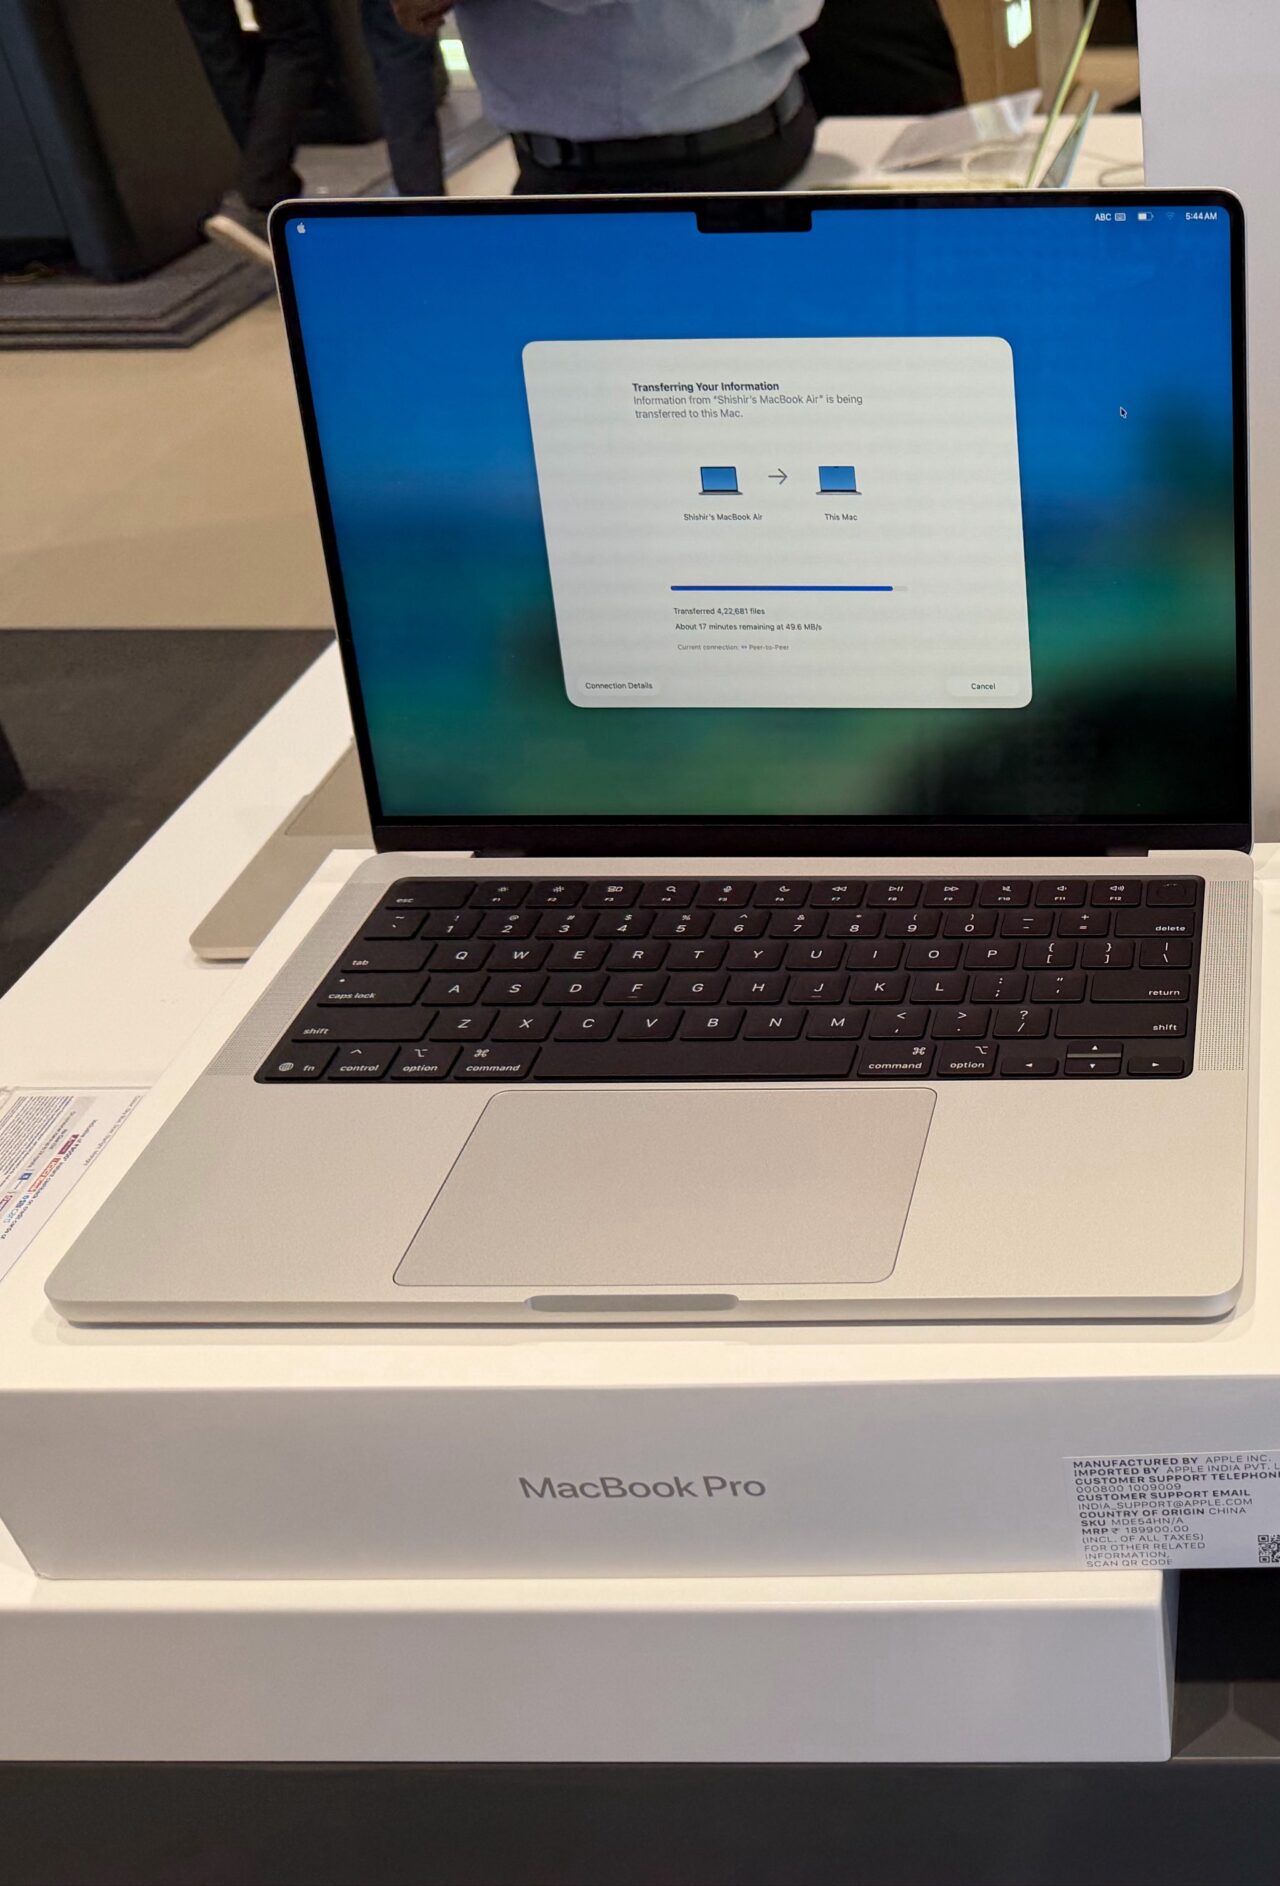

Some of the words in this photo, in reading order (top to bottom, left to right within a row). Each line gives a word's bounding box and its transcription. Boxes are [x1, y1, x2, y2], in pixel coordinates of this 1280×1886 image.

[1095, 213, 1111, 221] ABC
[632, 383, 694, 393] Transferring
[696, 383, 718, 392] Your
[721, 382, 780, 391] Information
[634, 396, 687, 405] Information
[689, 396, 711, 404] from
[760, 395, 804, 404] MacBook
[826, 395, 834, 404] is
[837, 394, 863, 405] being
[635, 410, 687, 418] transferred
[689, 410, 699, 418] to
[701, 409, 718, 418] this
[721, 409, 744, 418] Mac.
[683, 513, 715, 521] Shishir's
[717, 513, 750, 521] MacBook
[753, 513, 763, 521] Air
[825, 513, 840, 521] This
[842, 513, 857, 521] Mac
[717, 608, 748, 616] 4,22,681
[739, 623, 775, 632] remaining
[585, 682, 626, 690] Connection
[971, 682, 996, 690] Cancel
[1155, 924, 1186, 932] delete
[352, 958, 369, 966] tab
[328, 992, 352, 1001] caps
[353, 991, 376, 1000] lock
[1148, 989, 1180, 997] return
[303, 1026, 330, 1035] shift
[1152, 1023, 1178, 1031] shift
[303, 1064, 315, 1072] fn
[340, 1064, 379, 1072] control
[402, 1064, 438, 1074] option
[466, 1063, 520, 1072] command
[868, 1062, 922, 1070] command
[950, 1061, 985, 1070] option
[1073, 1458, 1179, 1468] MANUFACTURED
[1182, 1457, 1198, 1465] BY
[1205, 1456, 1243, 1464] APPLE
[1247, 1454, 1271, 1463] INC.
[1074, 1468, 1139, 1477] IMPORTED
[1144, 1467, 1159, 1475] BY
[1166, 1465, 1204, 1474] APPLE
[1207, 1464, 1241, 1472] INDIA
[1075, 1476, 1145, 1486] CUSTOMER
[1149, 1474, 1207, 1483] SUPPORT
[518, 1475, 699, 1499] MacBook
[702, 1475, 767, 1497] Pro
[1076, 1485, 1124, 1493] 000800
[1128, 1483, 1182, 1491] 1009009
[1077, 1492, 1147, 1502] CUSTOMER
[1150, 1491, 1208, 1499] SUPPORT
[1212, 1489, 1250, 1497] EMAIL
[1080, 1510, 1138, 1519] COUNTRY
[1142, 1509, 1158, 1517] OF
[1162, 1508, 1205, 1516] ORIGIN
[1209, 1507, 1247, 1515] CHINA
[1081, 1519, 1106, 1527] SKU
[1082, 1527, 1109, 1535] MRP
[1082, 1535, 1117, 1544] (INCL.
[1120, 1535, 1135, 1543] OF
[1139, 1534, 1159, 1542] ALL
[1163, 1533, 1204, 1542] TAXES)
[1084, 1544, 1107, 1552] FOR
[1110, 1543, 1150, 1551] OTHER
[1153, 1542, 1206, 1550] RELATED
[1122, 1559, 1138, 1567] QR
